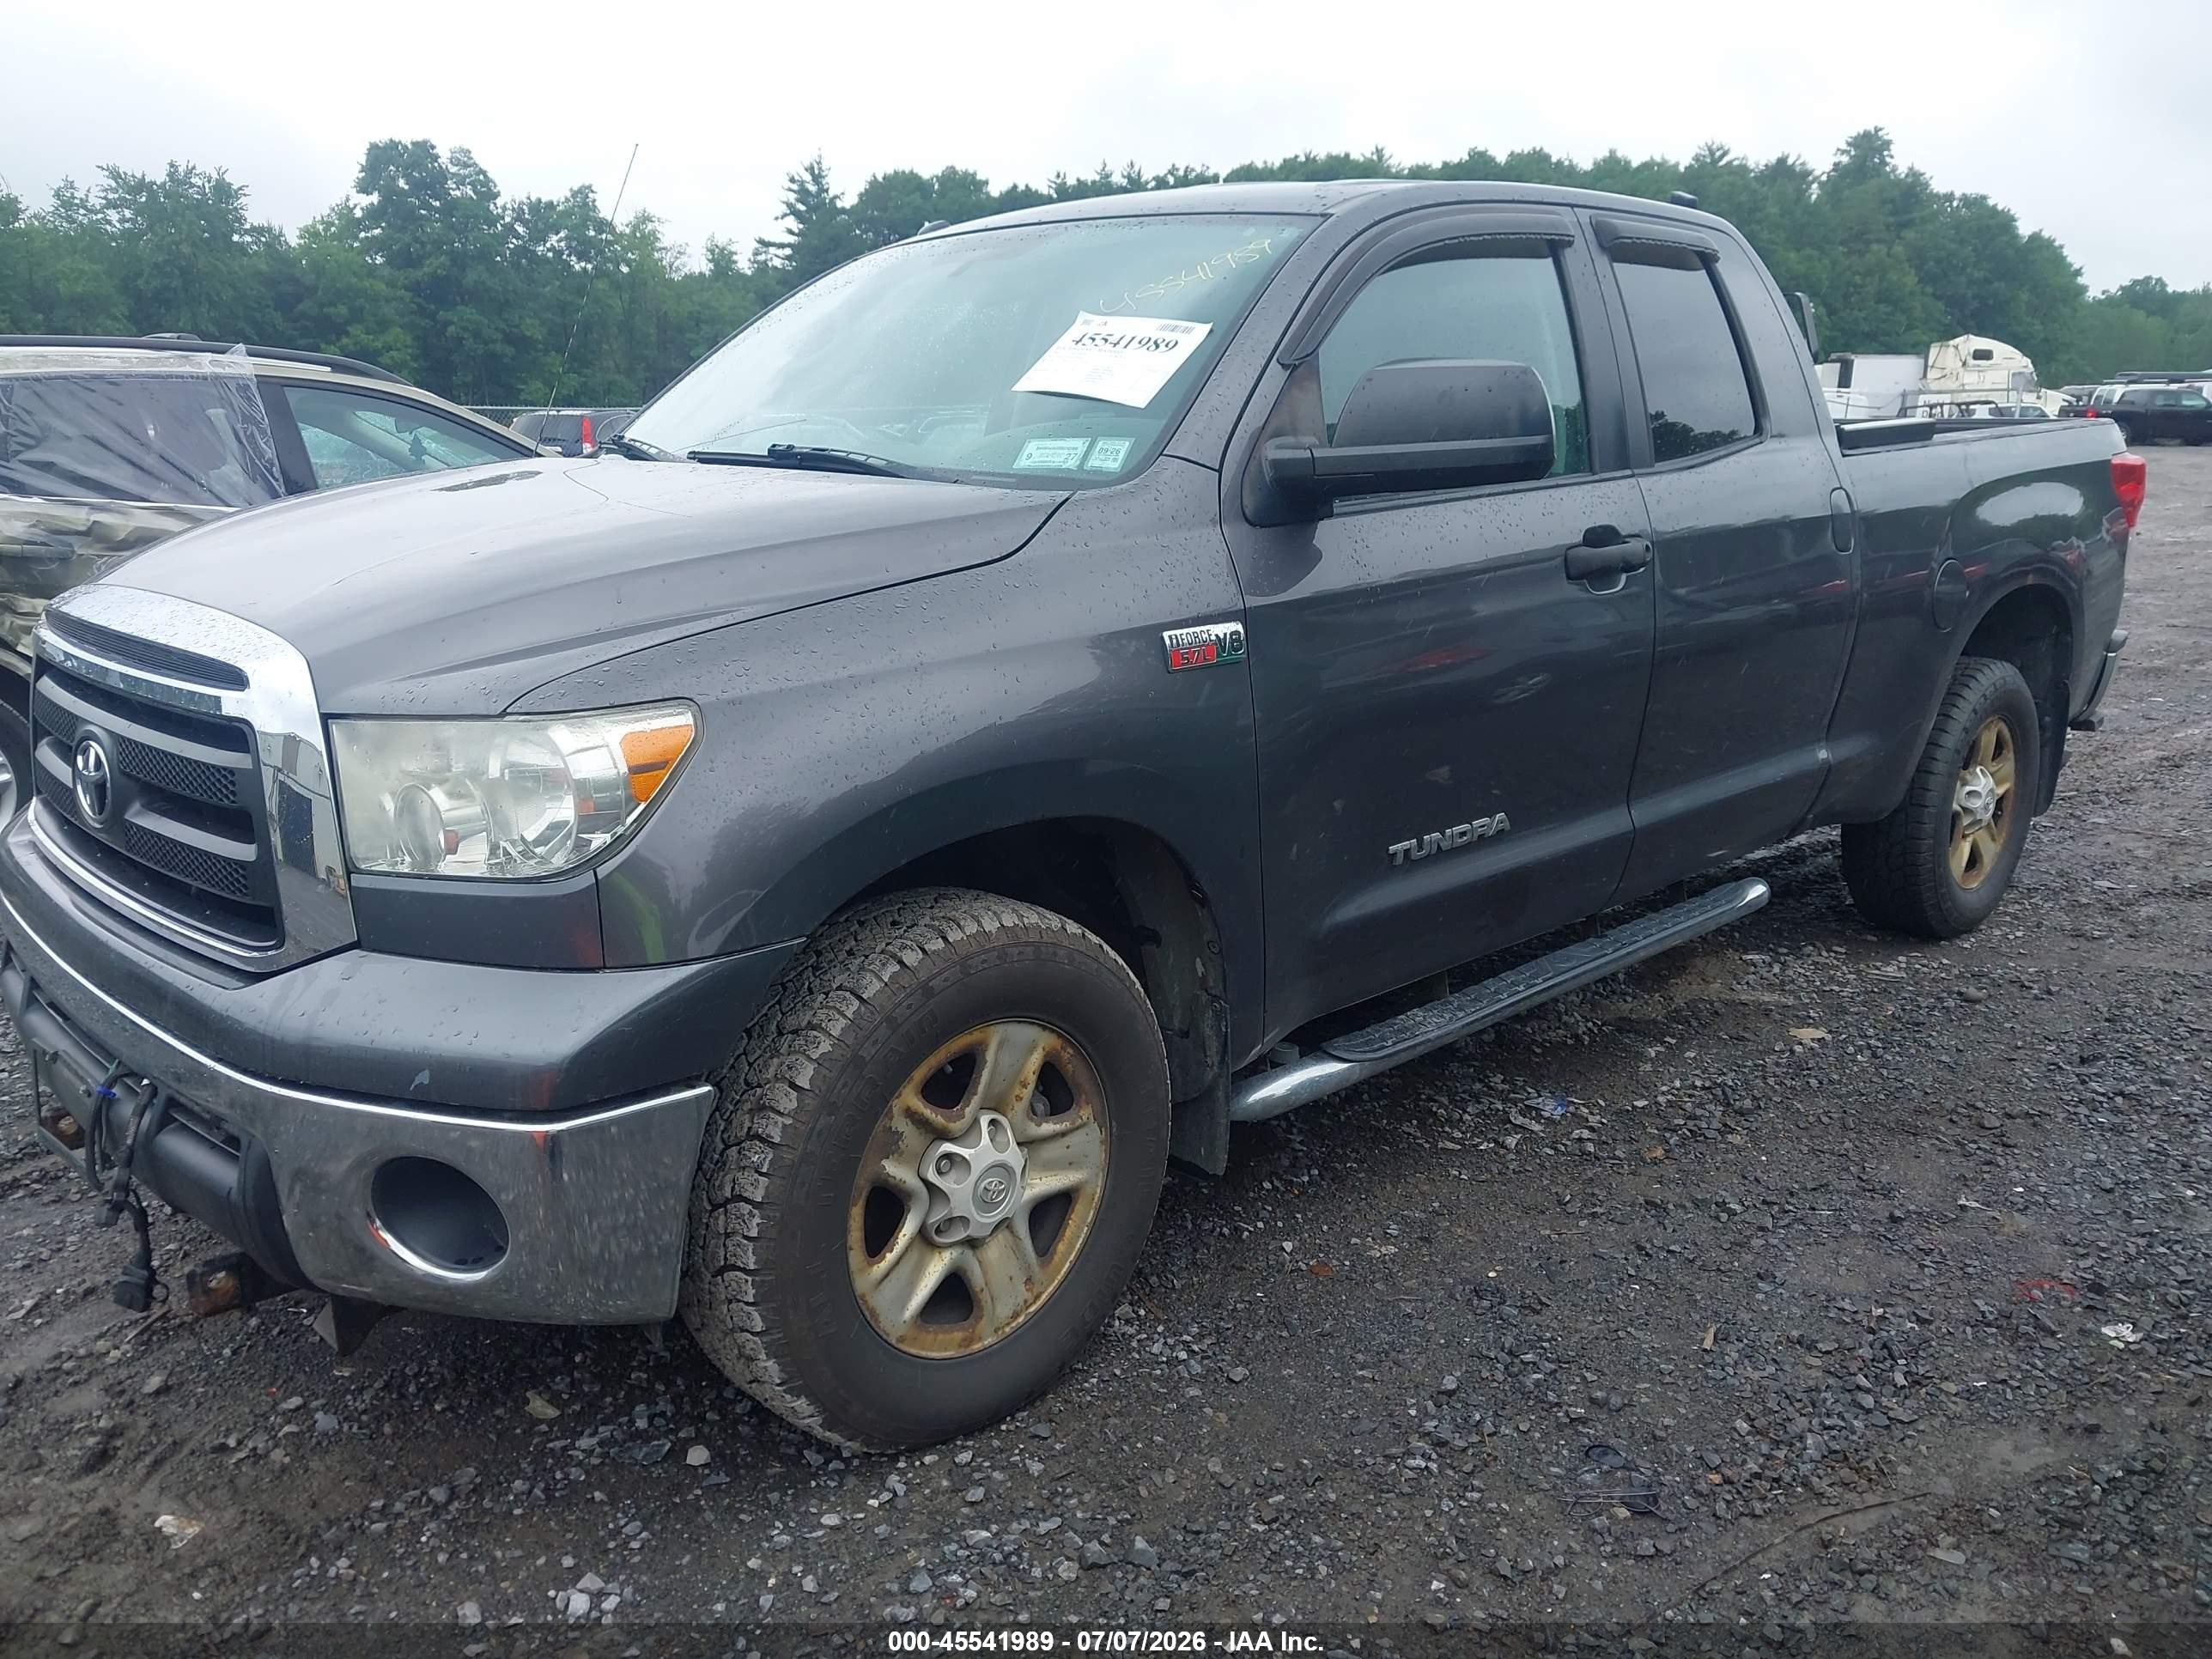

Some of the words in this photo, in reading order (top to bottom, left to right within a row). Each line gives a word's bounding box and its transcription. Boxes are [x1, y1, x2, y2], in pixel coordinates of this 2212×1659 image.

[1072, 332, 1179, 354] 45541989
[1215, 629, 1244, 656] V8
[1180, 647, 1212, 665] 5.7L
[1388, 811, 1511, 866] TUNDRA
